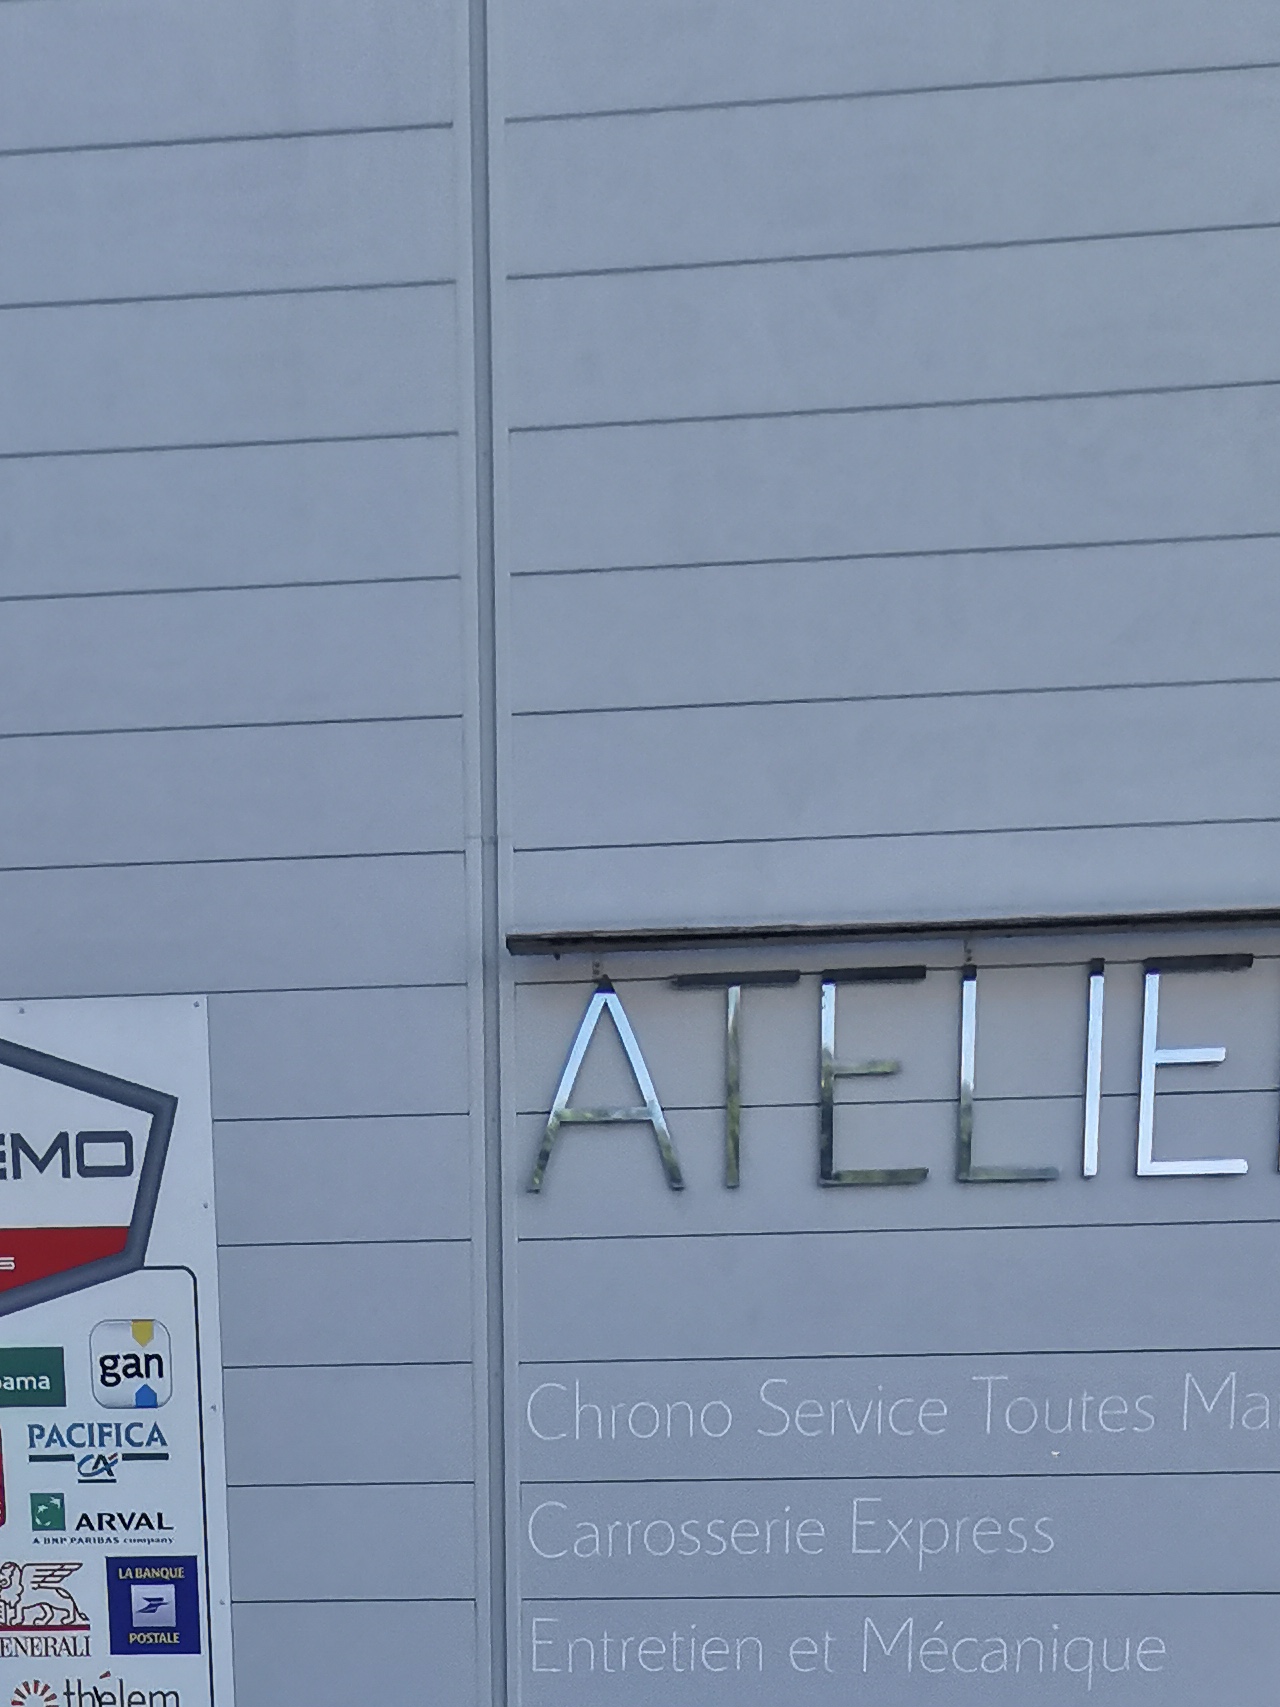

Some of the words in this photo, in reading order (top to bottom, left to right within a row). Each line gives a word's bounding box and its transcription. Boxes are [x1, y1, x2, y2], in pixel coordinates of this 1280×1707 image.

[98, 1352, 164, 1387] gan
[525, 1380, 734, 1442] Chrono
[756, 1377, 949, 1441] Service
[971, 1374, 1156, 1435] Toutes
[27, 1421, 169, 1449] PACIFICA
[75, 1512, 175, 1532] ARVAL
[526, 1501, 826, 1559] Carrosserie
[850, 1496, 1057, 1572] Express
[70, 1536, 120, 1544] PARIBAS
[118, 1567, 134, 1580] LA
[135, 1566, 186, 1580] BANQUE
[129, 1632, 181, 1645] POSTALE
[529, 1616, 764, 1674] Entretien
[788, 1630, 837, 1674] et
[861, 1616, 1167, 1692] Mécanique
